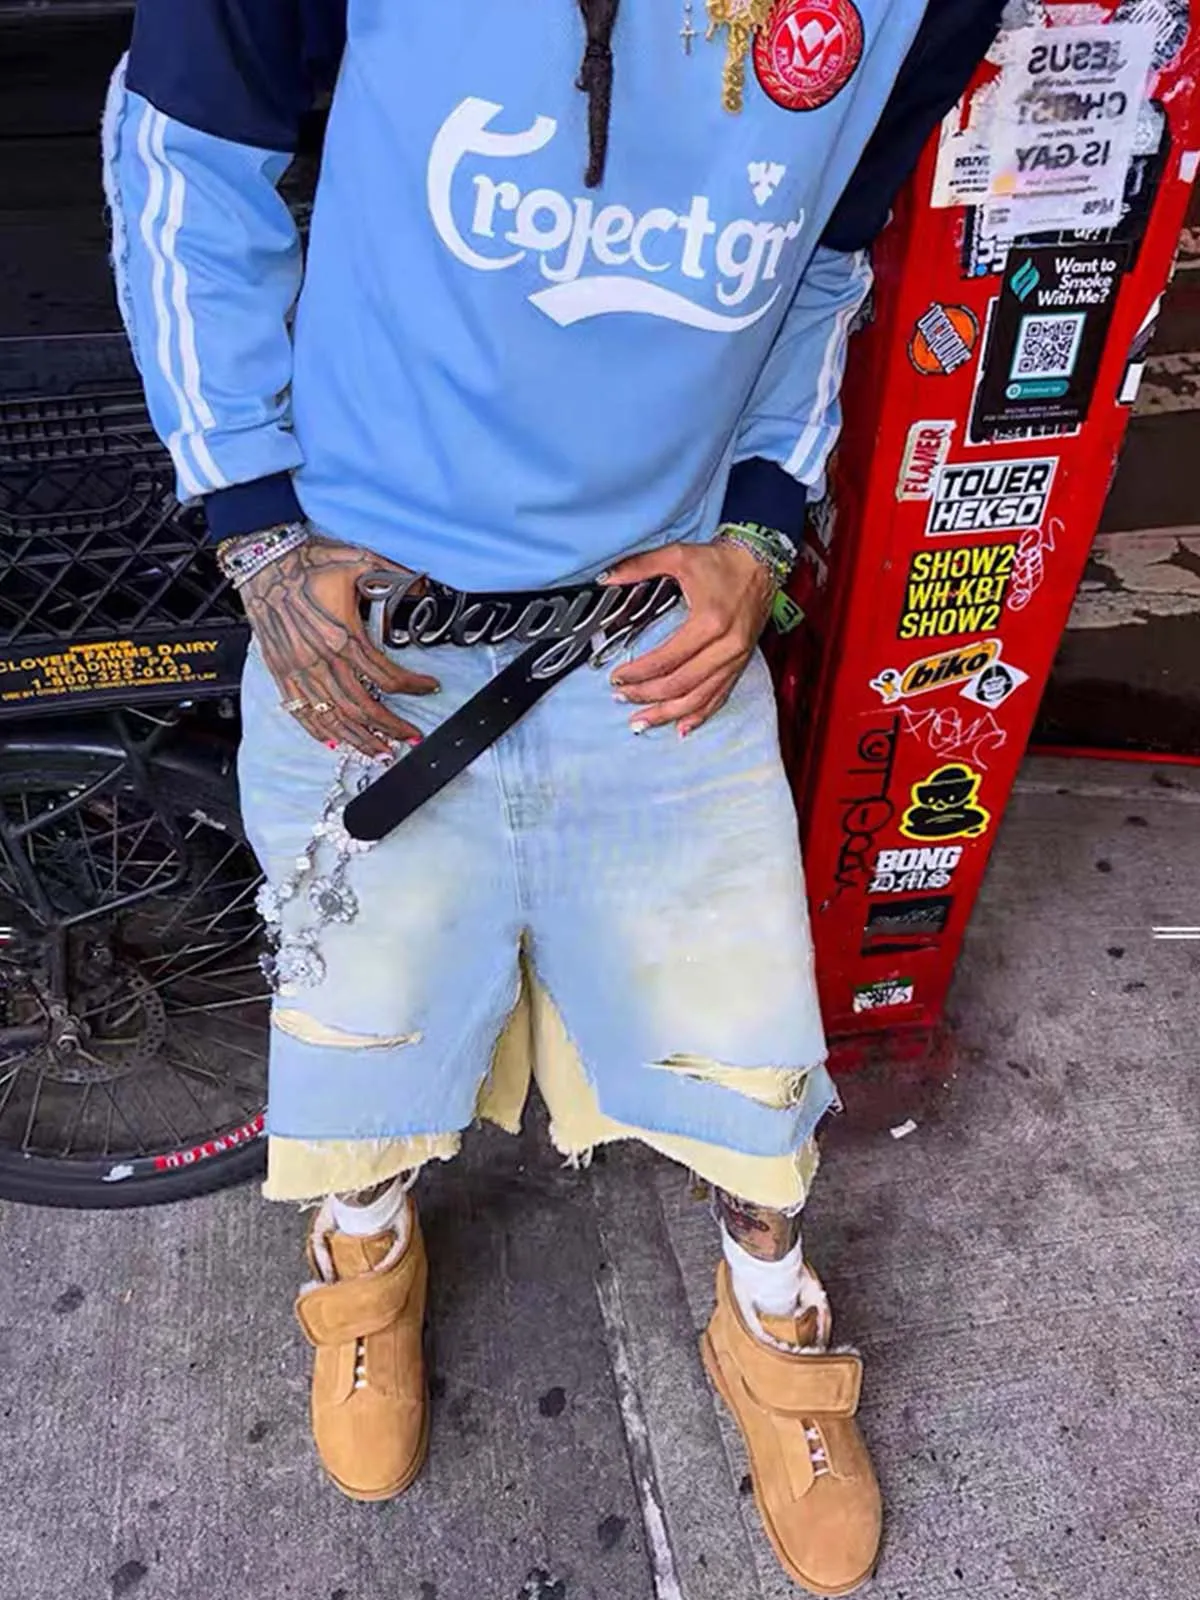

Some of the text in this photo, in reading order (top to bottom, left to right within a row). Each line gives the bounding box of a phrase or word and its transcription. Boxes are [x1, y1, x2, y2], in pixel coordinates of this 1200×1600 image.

[1055, 257, 1116, 274] Want to
[1059, 272, 1112, 289] Smoke
[1038, 288, 1110, 306] With Me?
[933, 495, 1041, 531] HEKSO
[910, 544, 1016, 581] SHOW2
[900, 604, 1000, 639] SHOW2
[83, 646, 152, 661] FARMS
[157, 640, 218, 655] DAIRY
[147, 655, 175, 667] PA
[907, 652, 989, 690] biko
[876, 846, 963, 872] BONG
